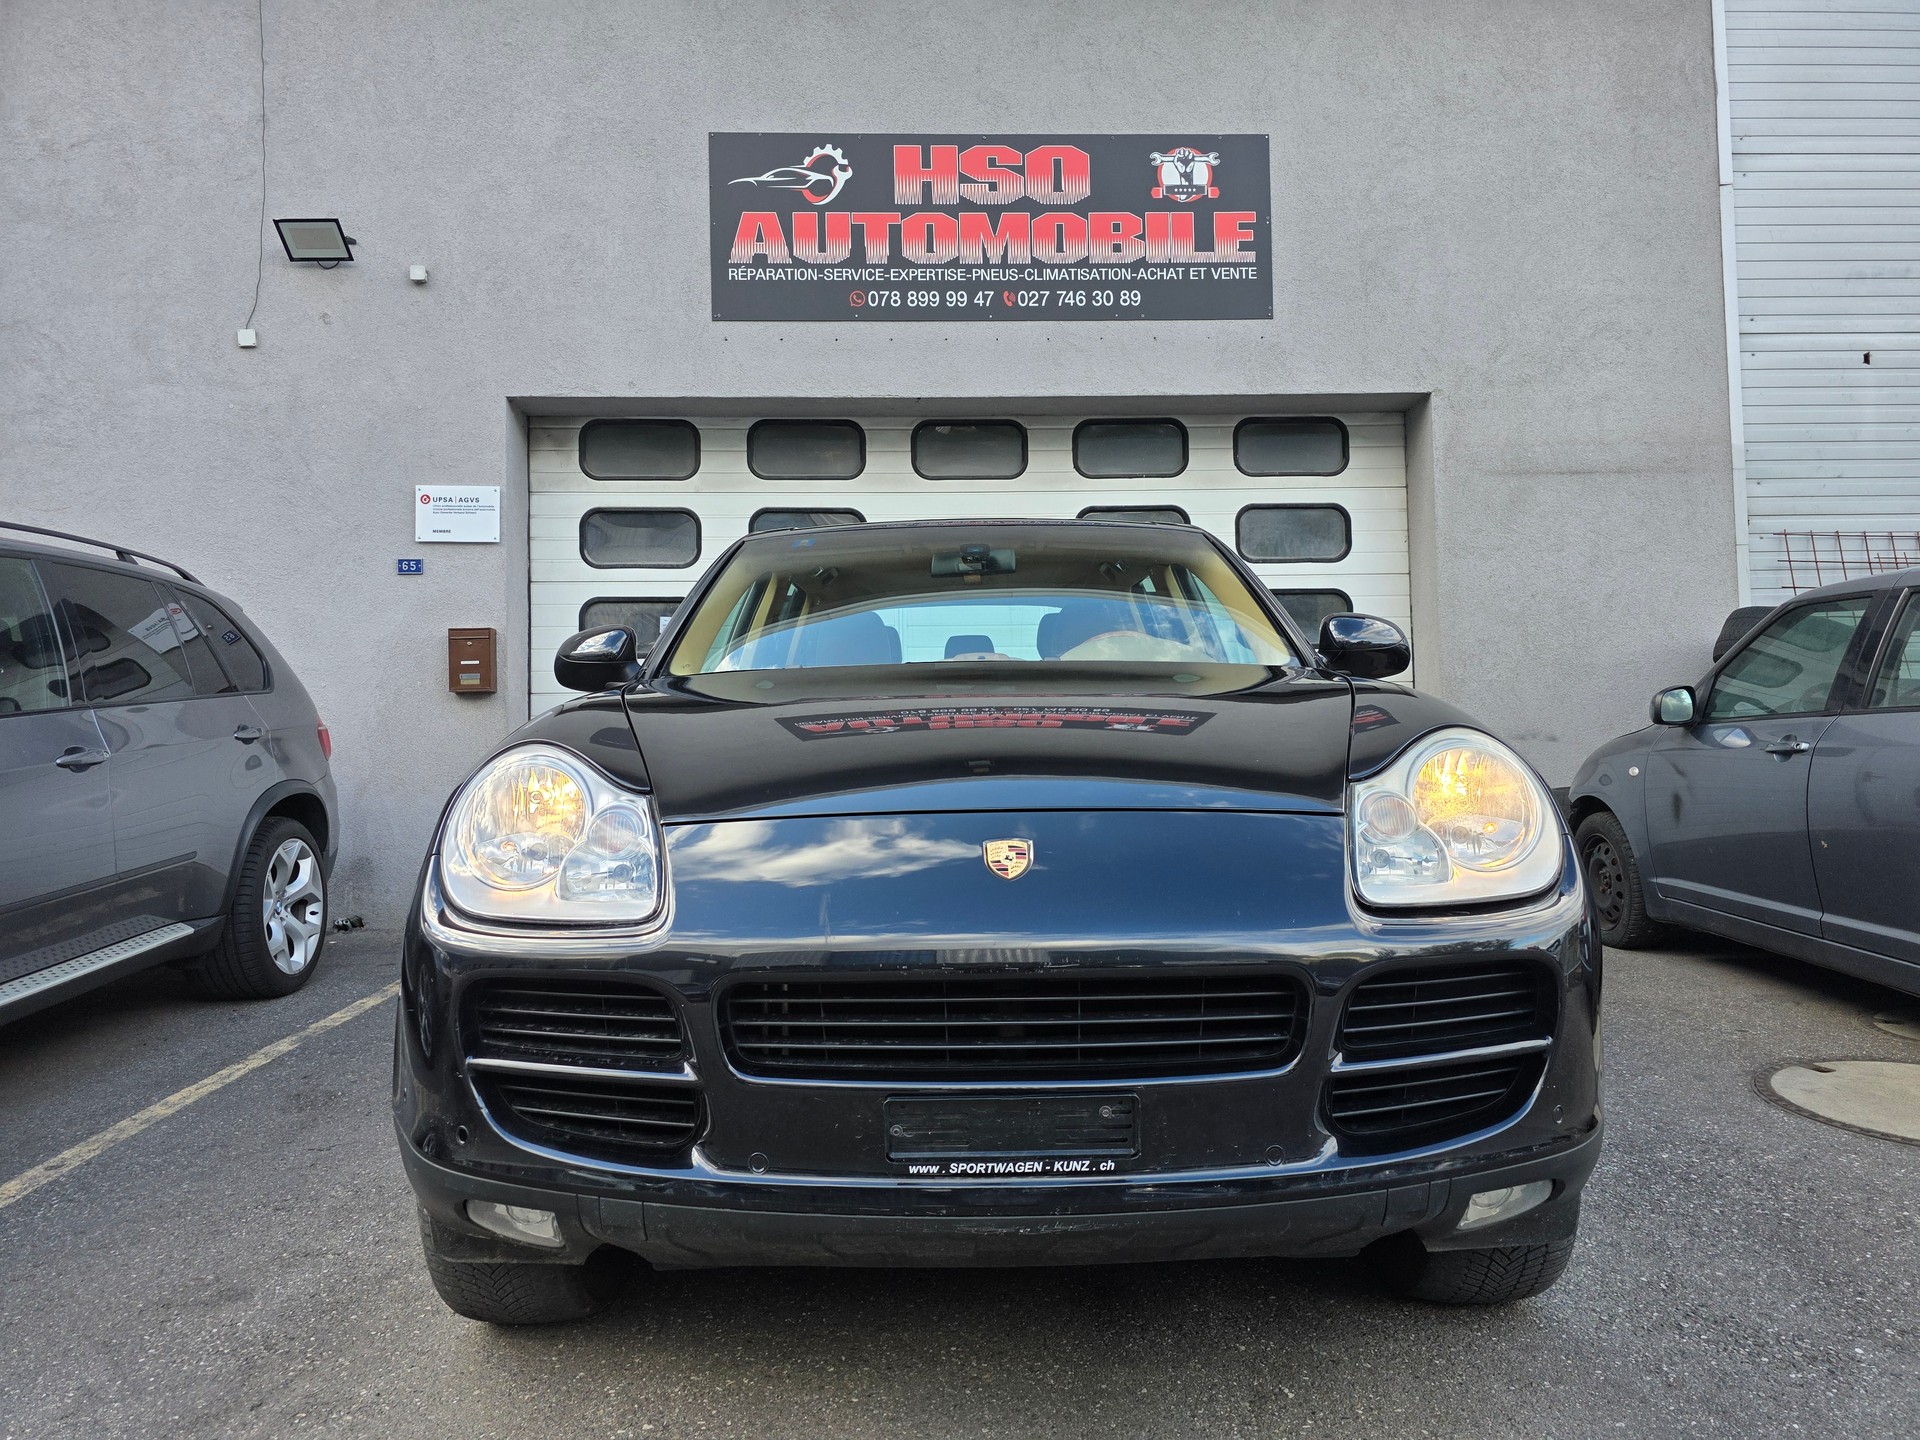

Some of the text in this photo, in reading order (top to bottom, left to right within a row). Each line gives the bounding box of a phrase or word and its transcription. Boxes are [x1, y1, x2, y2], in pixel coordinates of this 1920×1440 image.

[893, 144, 1091, 205] HSO
[728, 211, 1257, 265] AUTOMOBILE
[728, 265, 1258, 281] RÉPARATION-SERVICE-EXPERTISE-PNEUS-CLIMATISATION-ACHAT ET VENTE
[867, 291, 994, 307] 078 899 99 47
[1017, 290, 1142, 307] 027 746 30 89
[402, 561, 416, 571] 65
[949, 1161, 1043, 1174] SPORTWAGEN
[1053, 1161, 1090, 1172] KUNZ
[1099, 1160, 1115, 1171] ch
